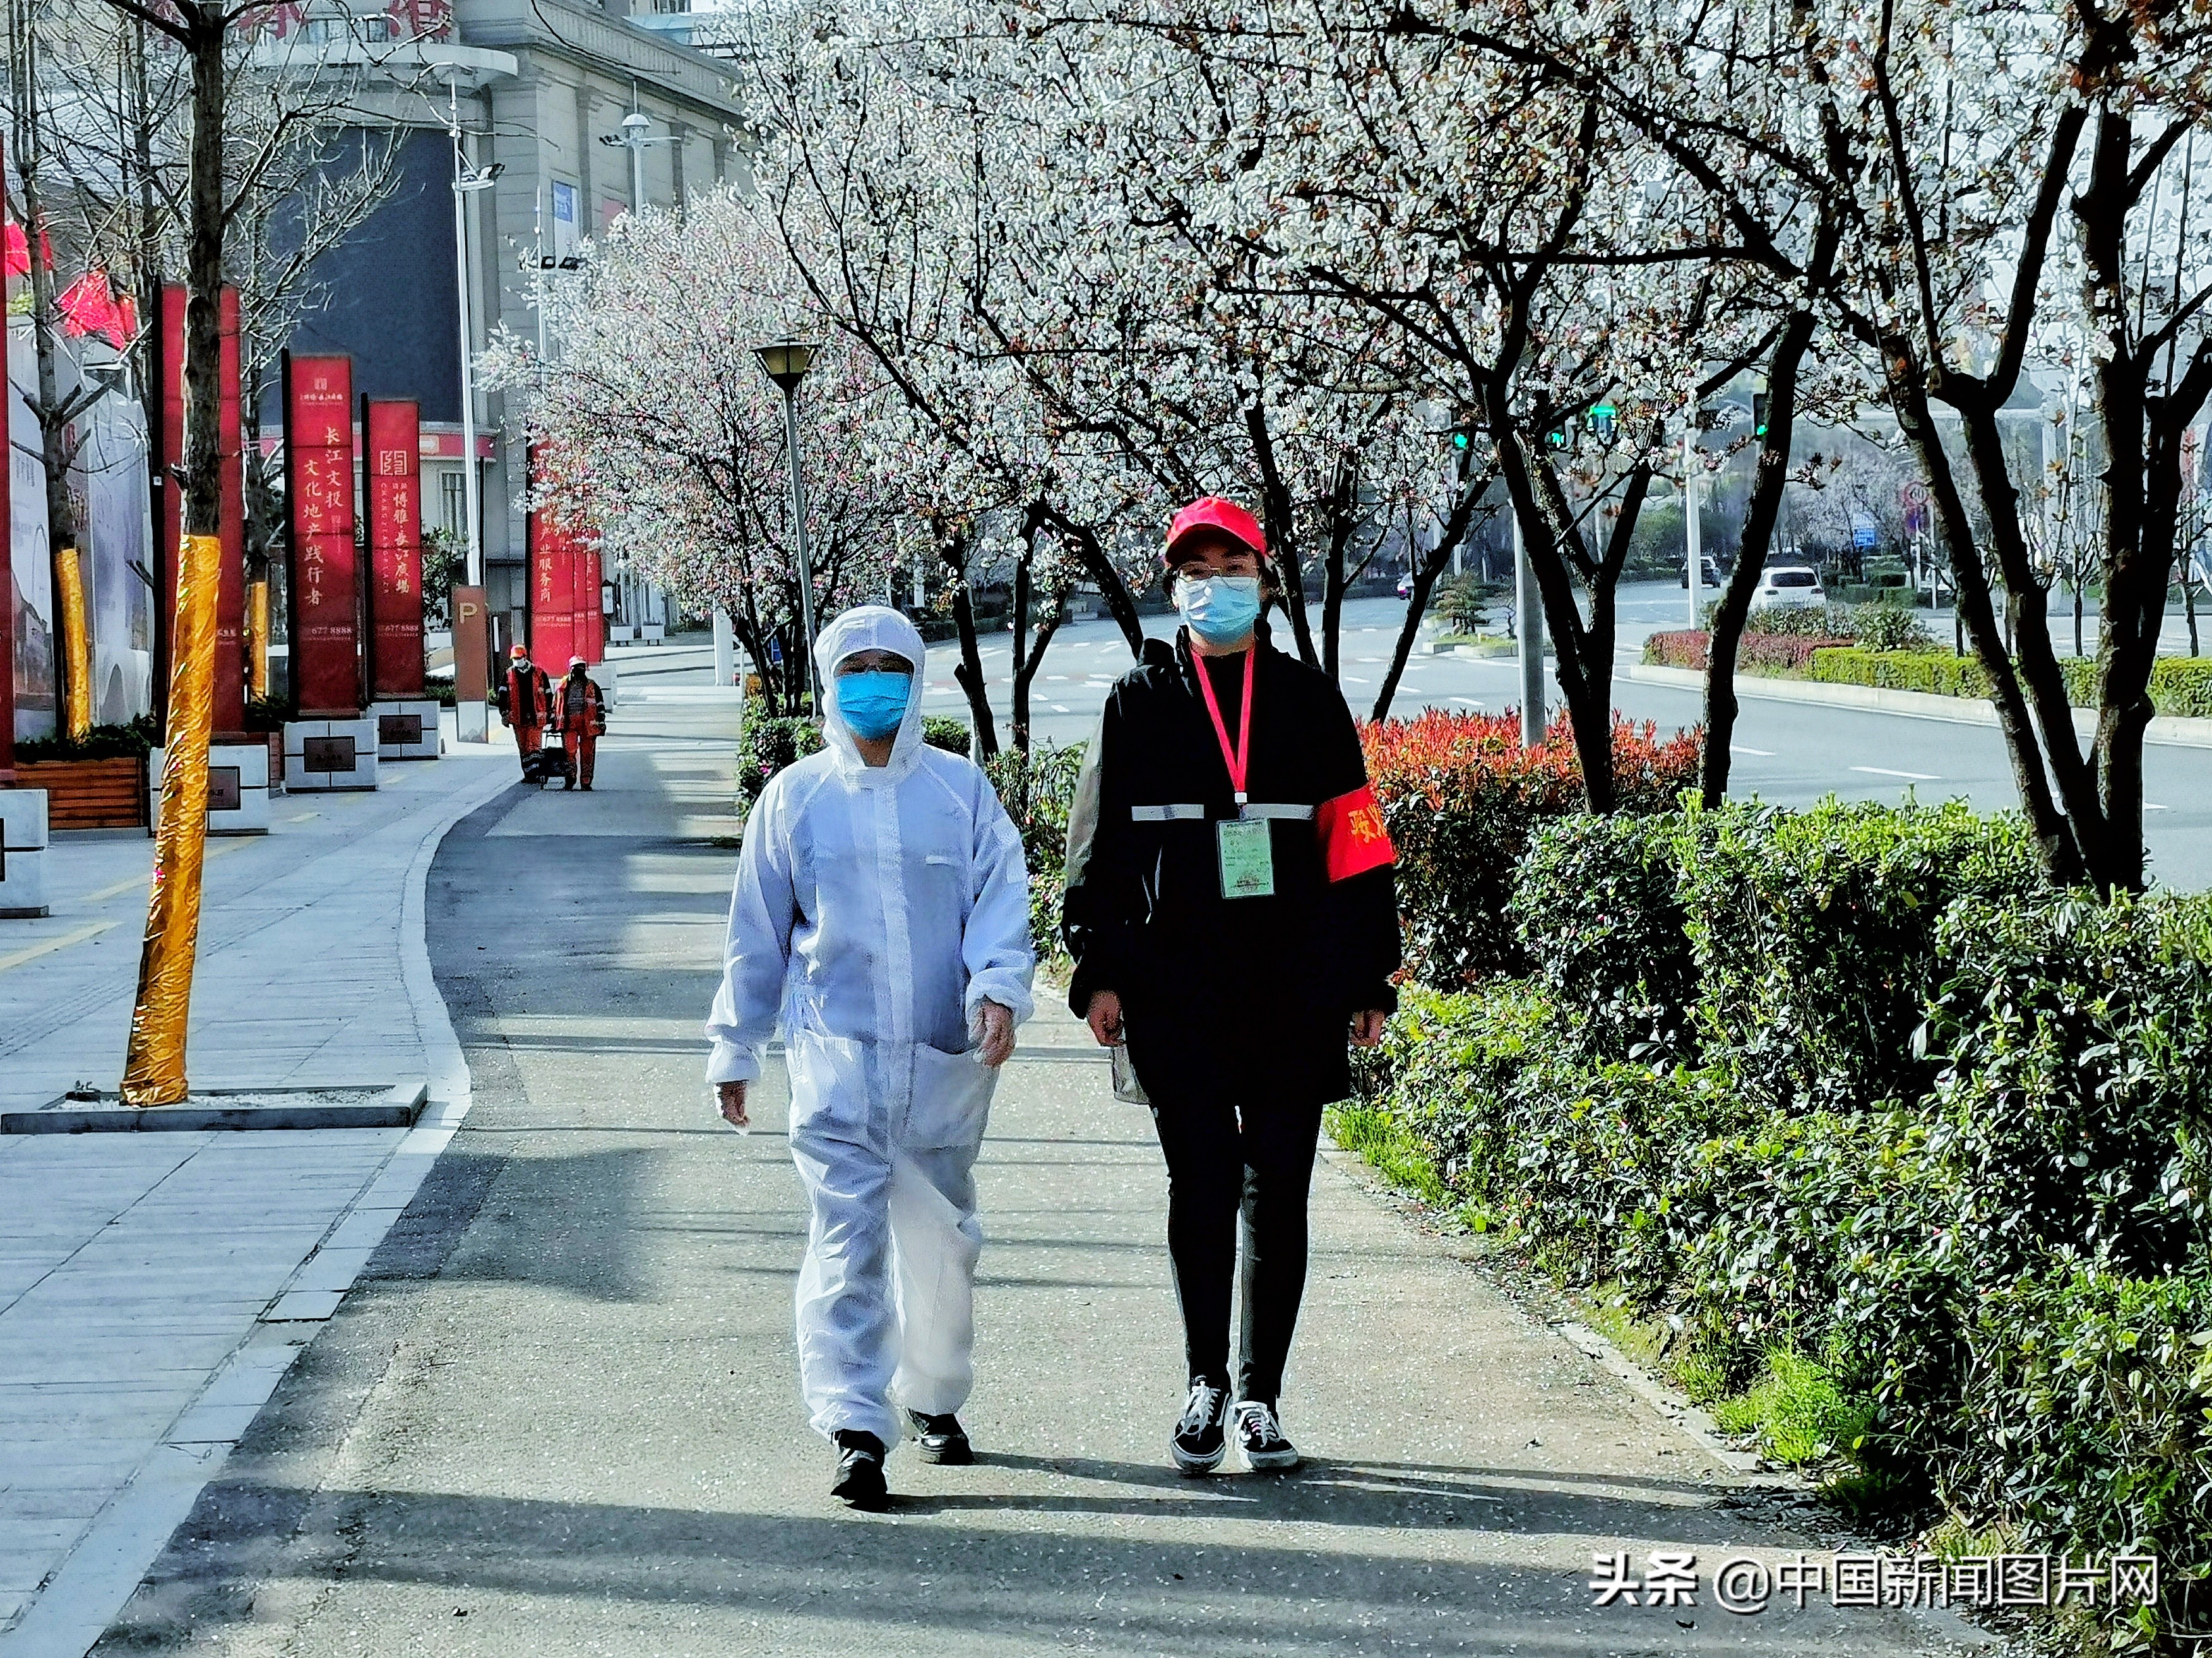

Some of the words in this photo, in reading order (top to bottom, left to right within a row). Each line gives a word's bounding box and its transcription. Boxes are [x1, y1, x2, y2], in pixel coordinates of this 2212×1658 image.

[303, 459, 324, 606] 文化地产践行者
[459, 602, 478, 624] P
